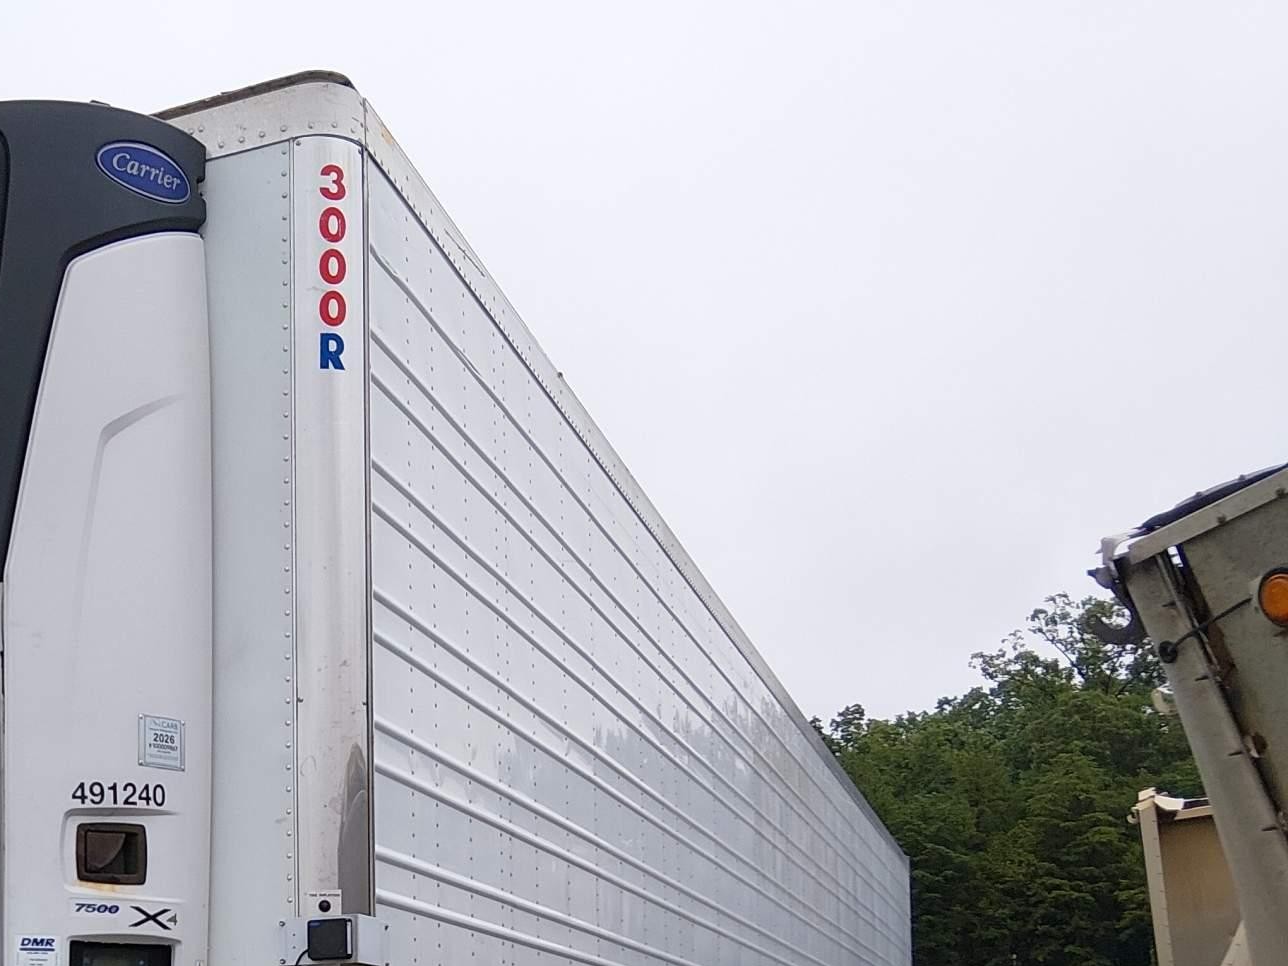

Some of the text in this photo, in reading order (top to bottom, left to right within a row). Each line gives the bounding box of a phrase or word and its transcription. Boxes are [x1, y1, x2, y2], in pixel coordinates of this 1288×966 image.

[112, 152, 182, 192] Carrier
[318, 164, 347, 371] 3000R
[153, 732, 175, 745] 2026
[71, 782, 166, 807] 491240
[75, 903, 120, 914] 7500
[20, 937, 56, 947] DMR
